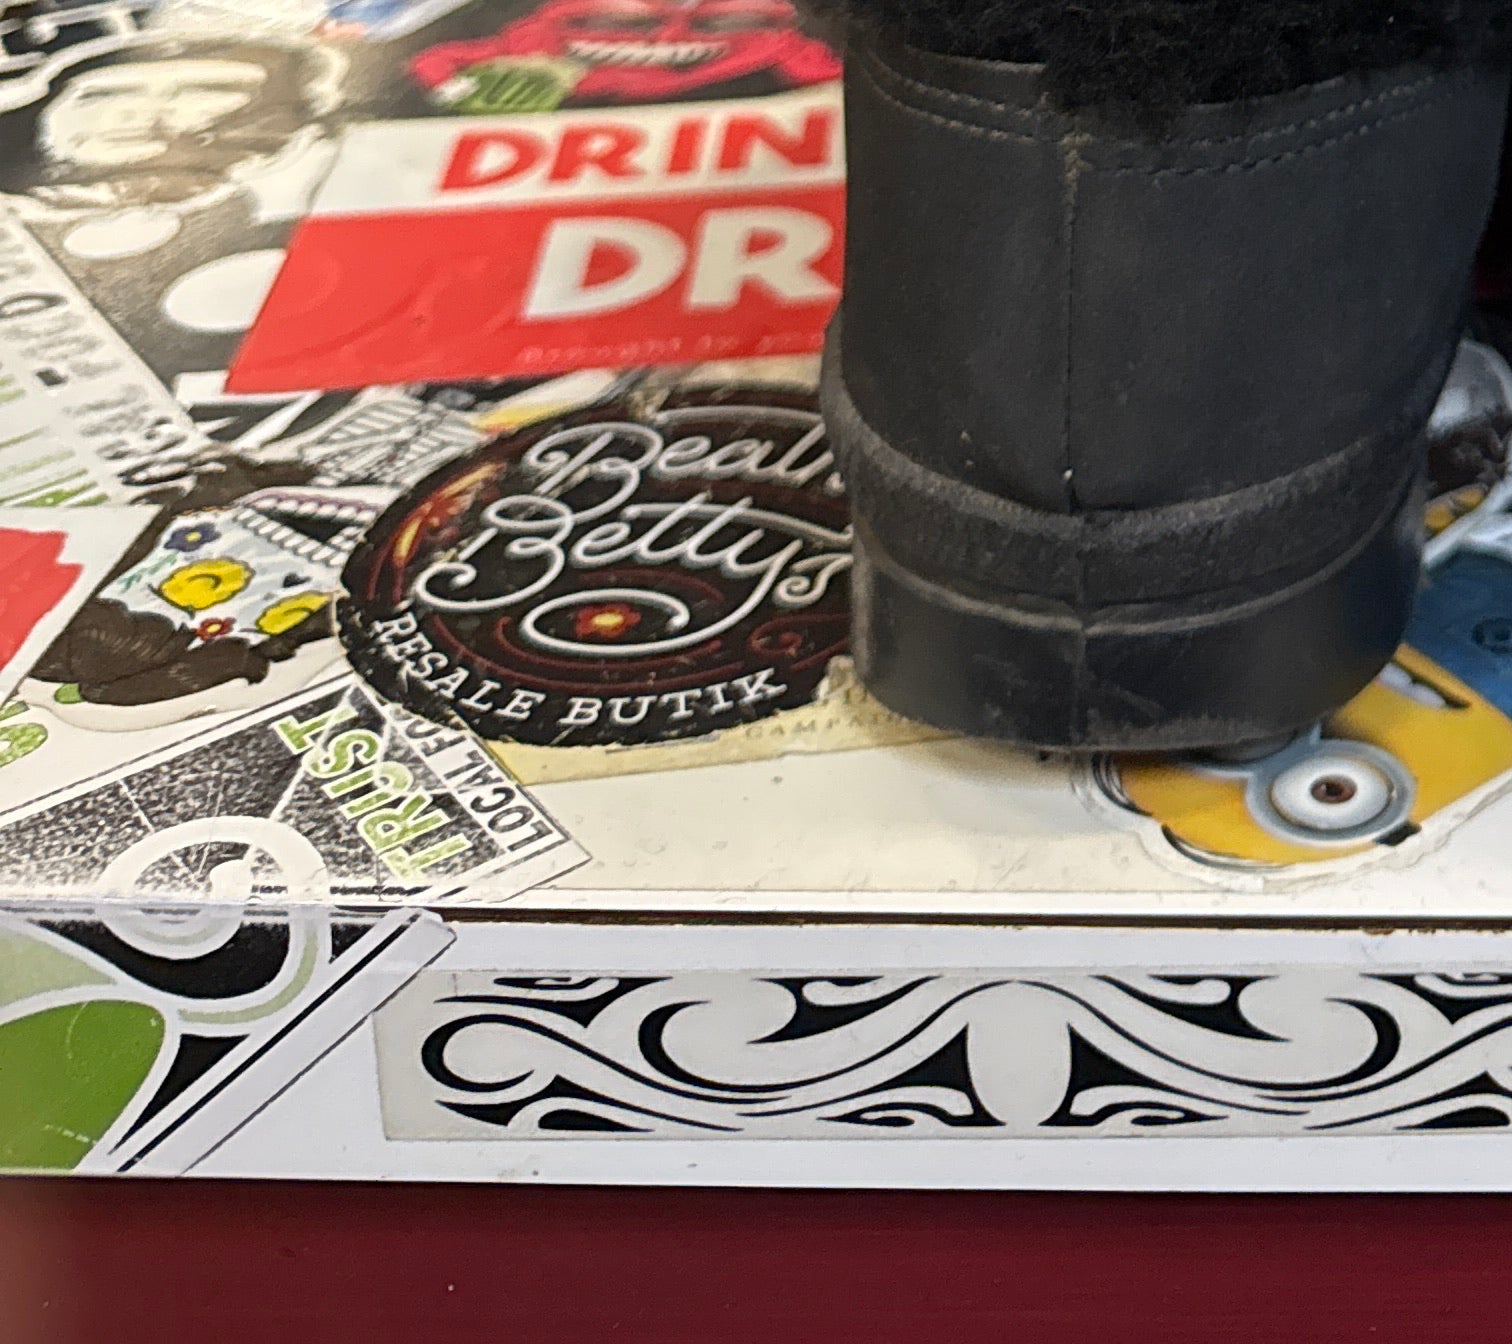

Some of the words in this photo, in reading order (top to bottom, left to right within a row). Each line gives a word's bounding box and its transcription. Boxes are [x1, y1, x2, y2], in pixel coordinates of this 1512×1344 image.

[438, 106, 836, 194] DRIN
[521, 205, 843, 322] DR
[369, 609, 547, 721] RESALE
[556, 666, 789, 728] BUTIK
[269, 703, 474, 883] TRUST
[443, 747, 556, 856] LOCAL
